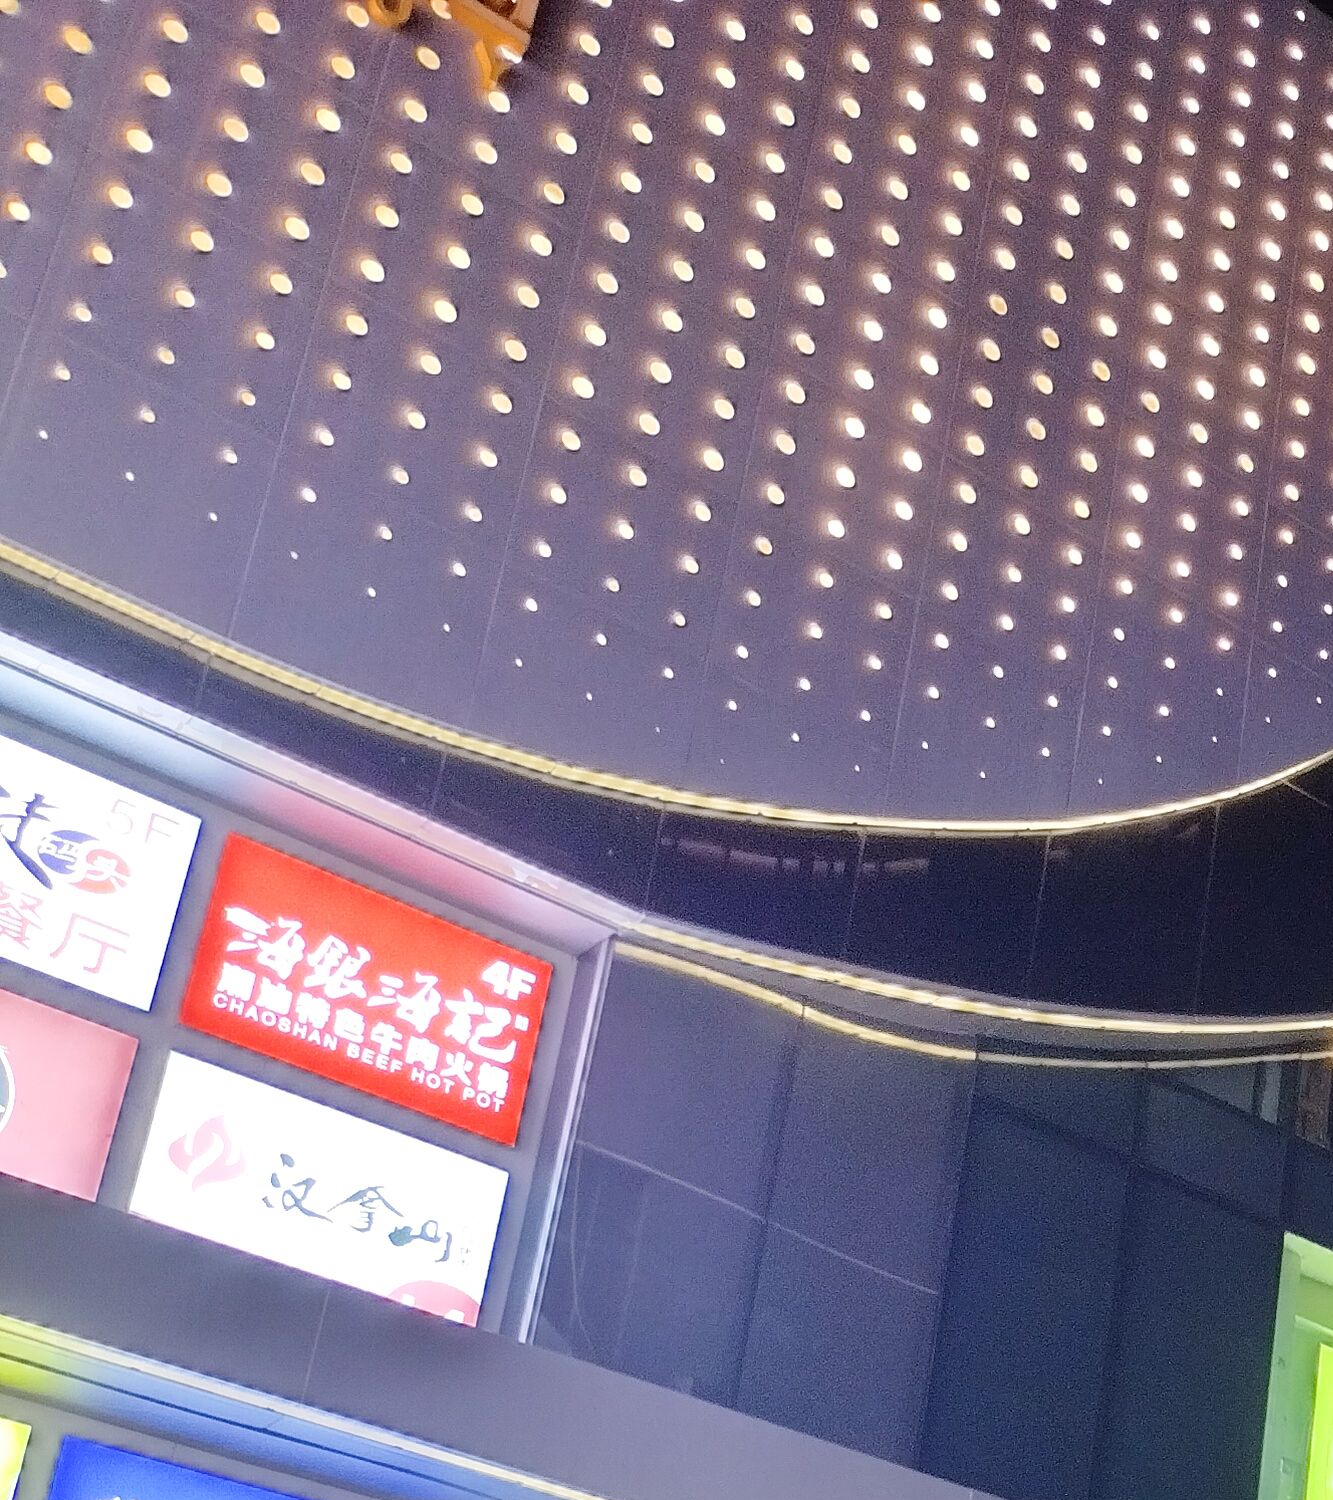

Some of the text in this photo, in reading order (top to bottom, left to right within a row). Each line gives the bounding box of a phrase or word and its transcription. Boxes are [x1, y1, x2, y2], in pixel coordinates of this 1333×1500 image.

[481, 960, 536, 1000] 4F
[213, 993, 505, 1112] CHAOSHAN BEEF HOT POT
